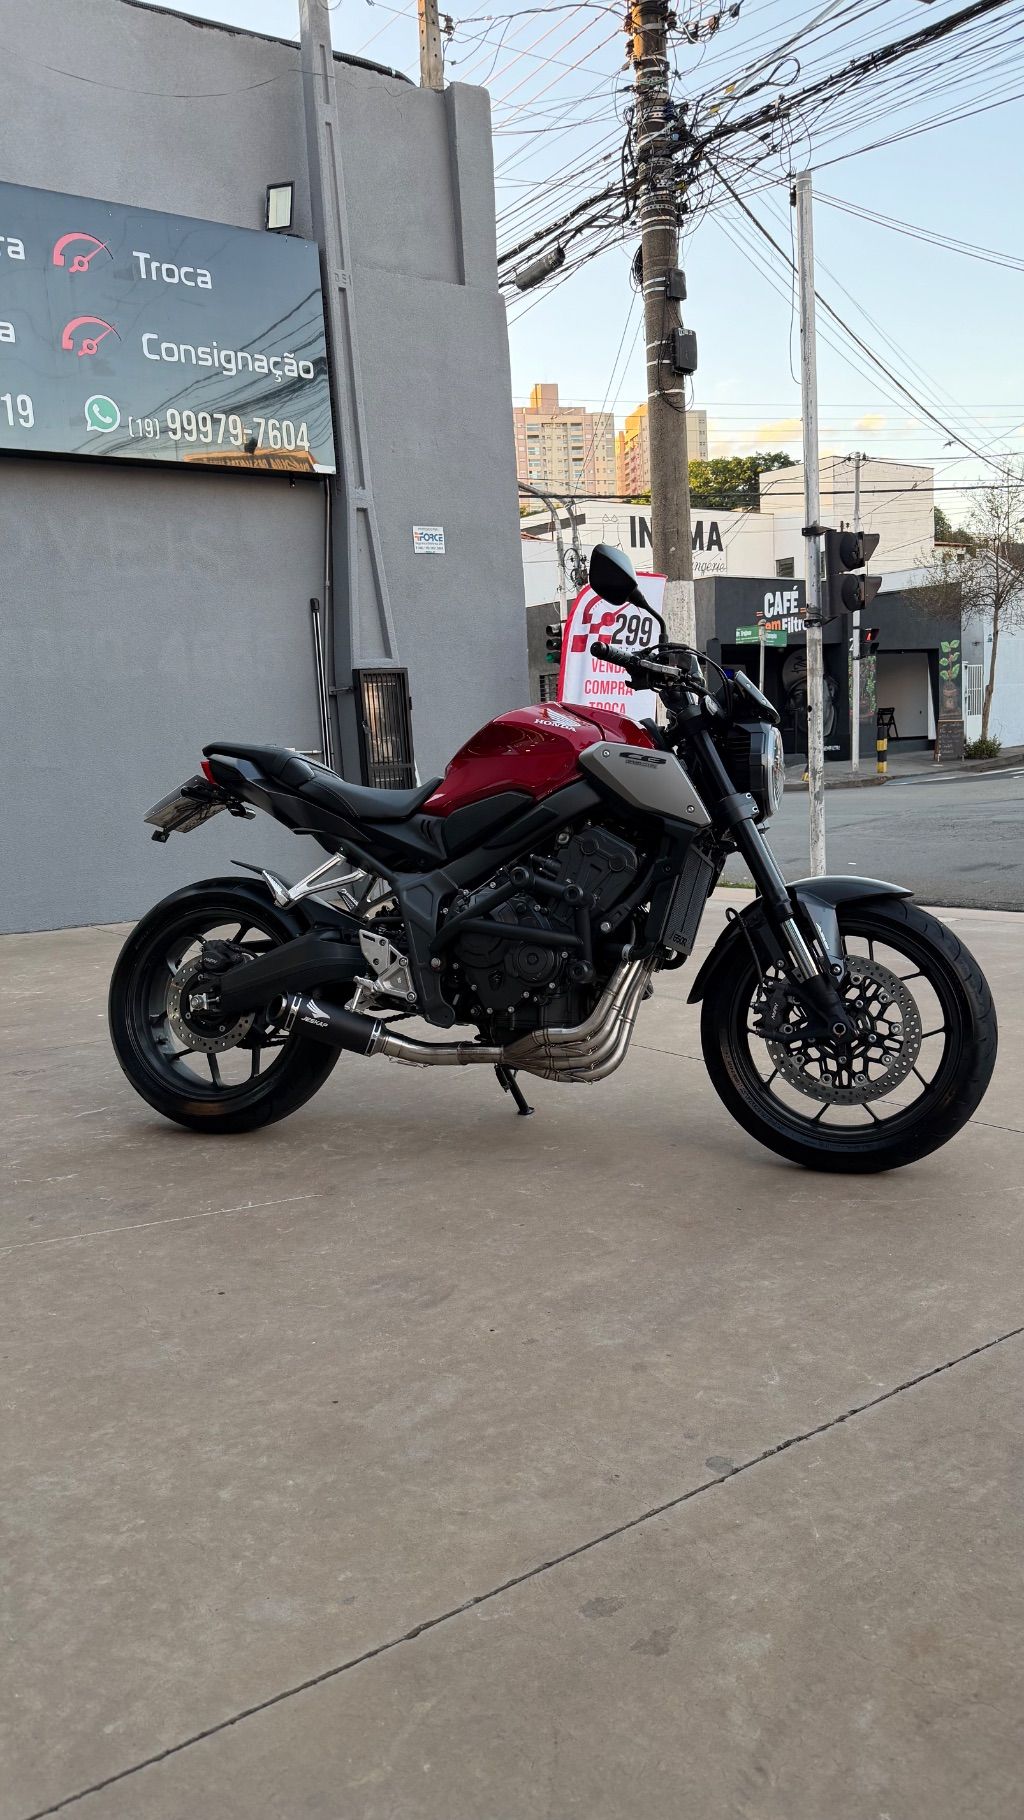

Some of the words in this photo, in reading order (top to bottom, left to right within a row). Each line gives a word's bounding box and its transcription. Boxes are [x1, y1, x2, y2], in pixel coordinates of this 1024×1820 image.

[132, 251, 213, 290] Troca
[141, 333, 314, 382] Consignação
[128, 416, 160, 440] (19)
[166, 408, 311, 452] 99979-7604
[764, 585, 799, 618] CAFÉ
[611, 613, 653, 647] 299
[534, 719, 577, 733] HONDA
